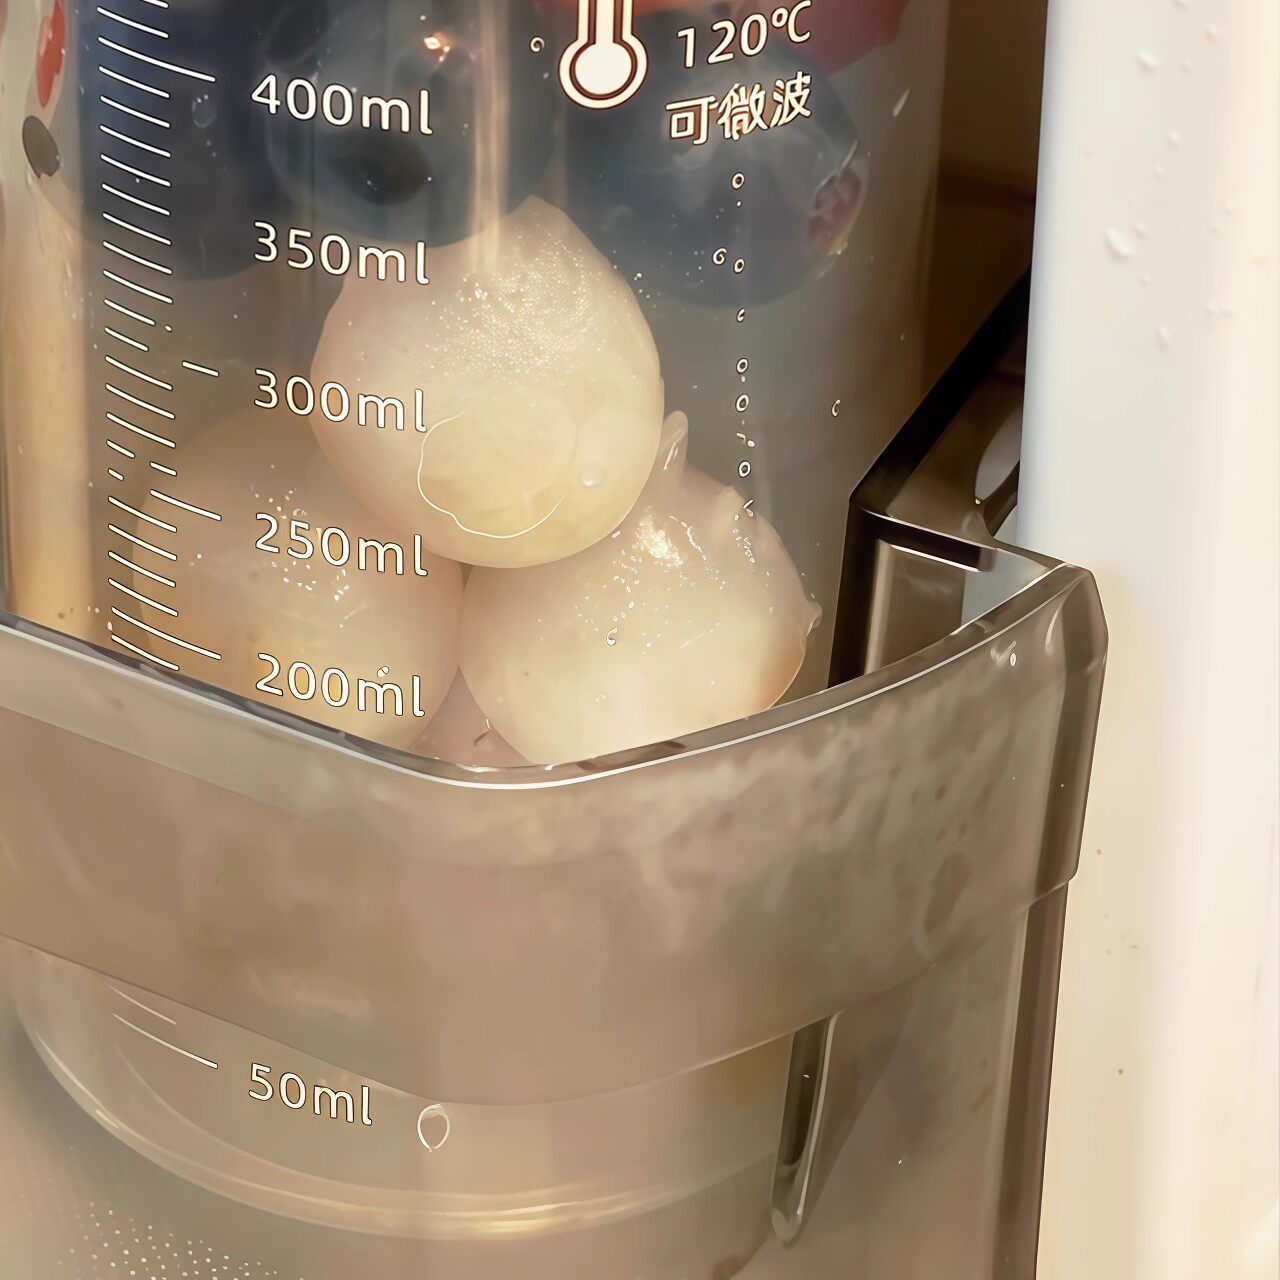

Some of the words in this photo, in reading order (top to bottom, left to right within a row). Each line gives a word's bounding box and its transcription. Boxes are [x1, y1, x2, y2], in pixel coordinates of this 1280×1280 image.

[251, 74, 433, 135] 400ml
[665, 70, 812, 146] 可微波
[253, 220, 429, 285] 350ml
[253, 368, 427, 433] 300ml
[253, 512, 429, 577] 250ml
[255, 652, 426, 718] 200ml
[247, 1062, 373, 1126] 50ml
